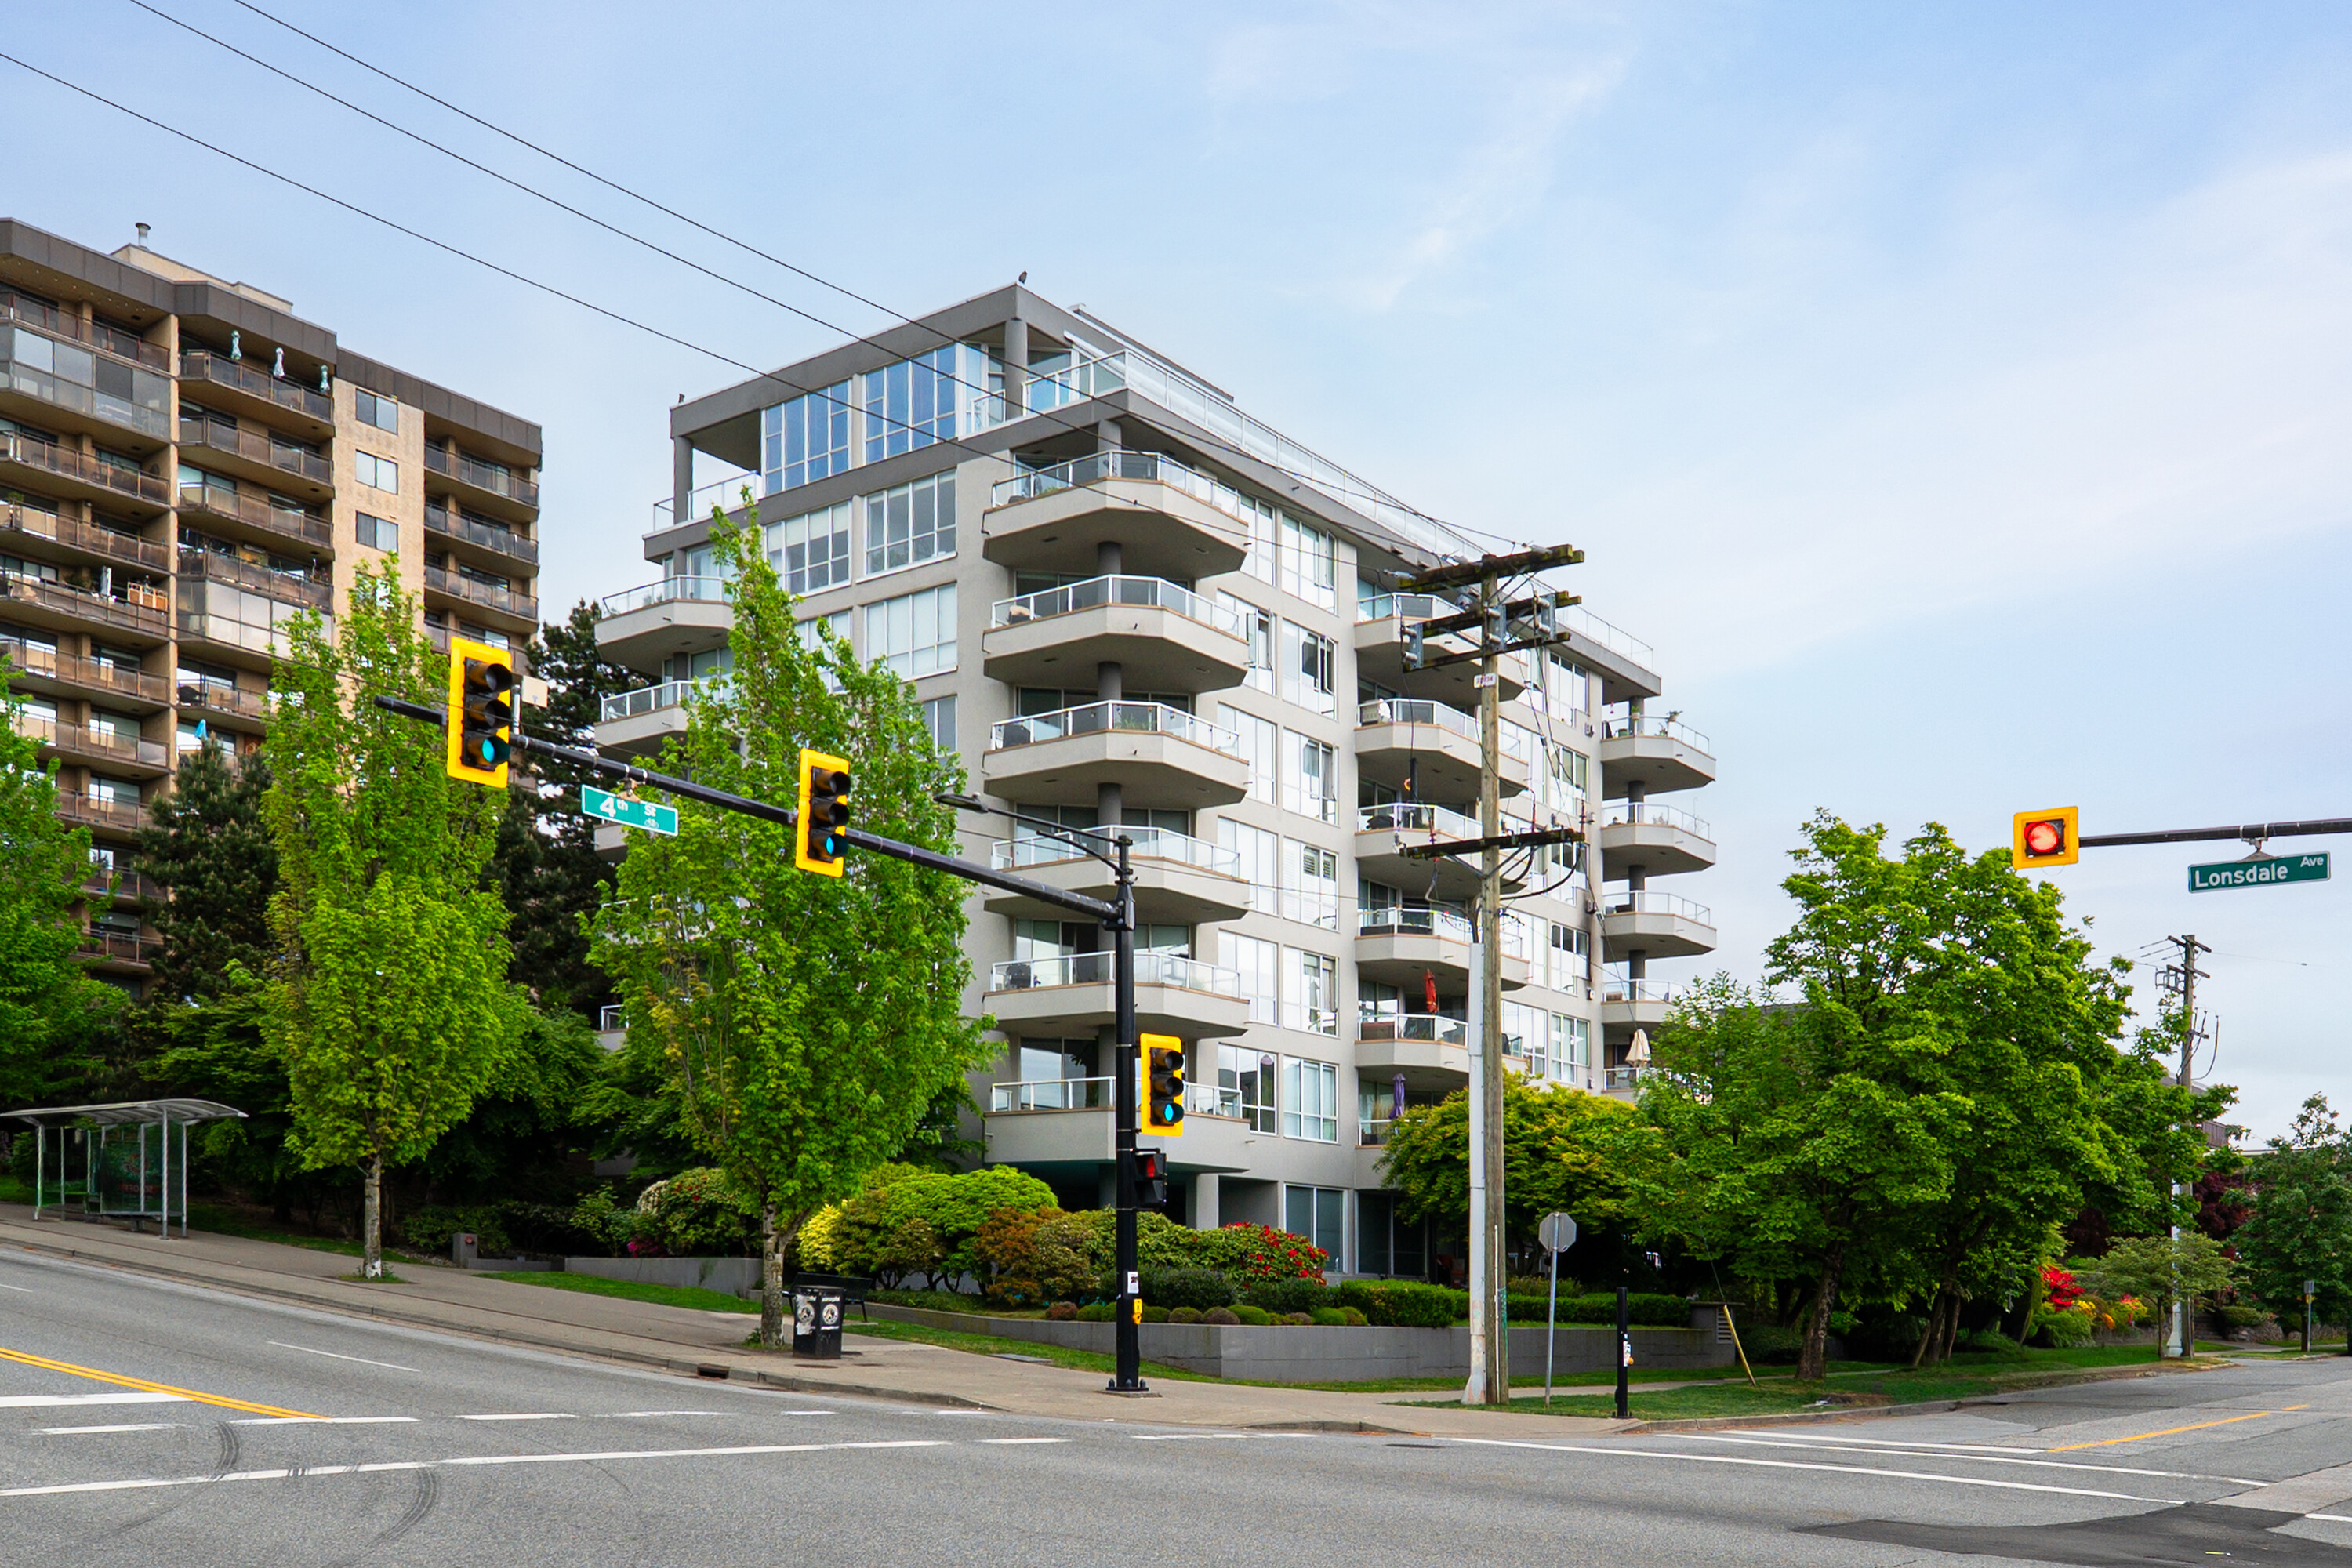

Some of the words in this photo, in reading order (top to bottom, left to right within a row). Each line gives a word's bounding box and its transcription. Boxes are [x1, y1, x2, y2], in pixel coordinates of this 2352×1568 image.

[600, 797, 628, 818] 4th
[644, 804, 656, 817] St
[2195, 863, 2288, 887] Lonsdale
[2300, 856, 2324, 867] Ave
